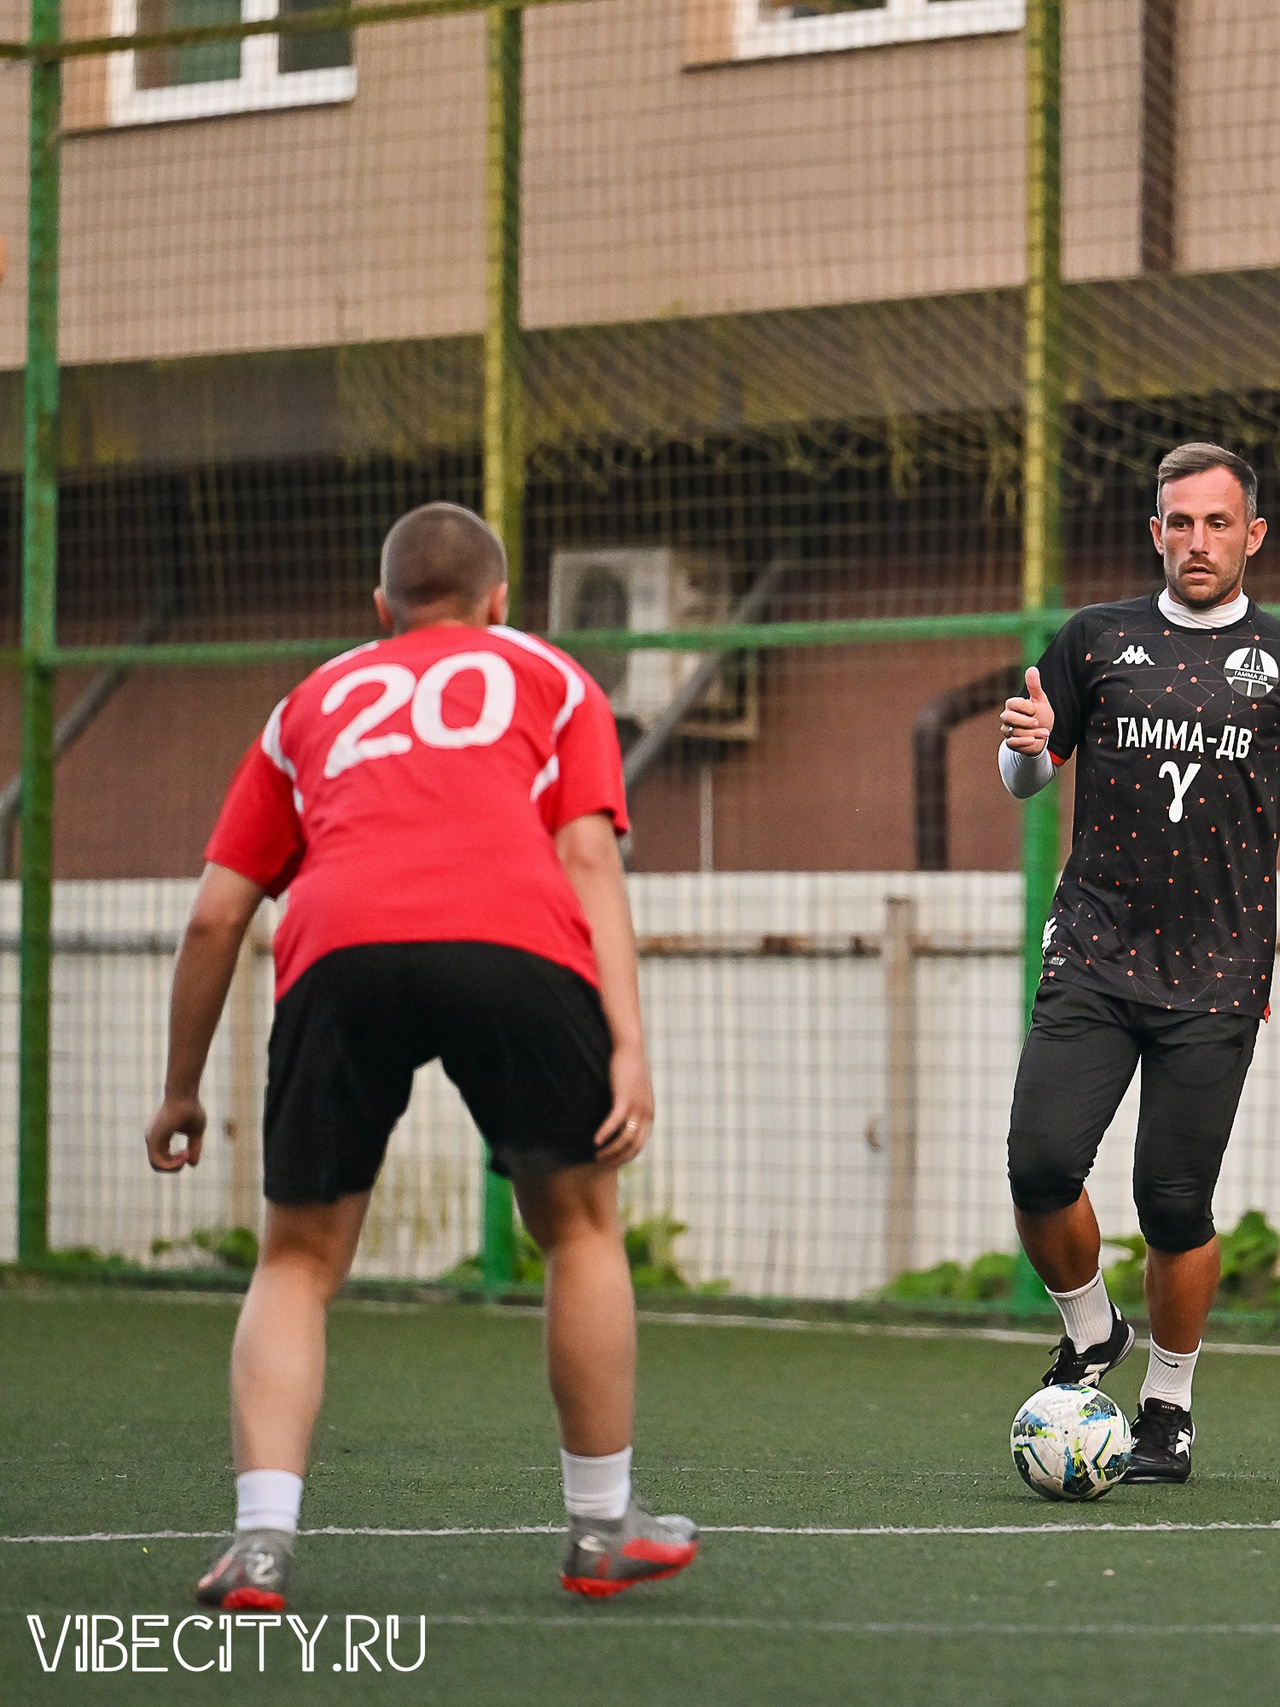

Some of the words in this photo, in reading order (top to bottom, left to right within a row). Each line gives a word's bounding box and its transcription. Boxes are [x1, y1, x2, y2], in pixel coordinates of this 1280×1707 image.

[1234, 670, 1258, 679] ГАММА
[321, 650, 517, 779] 20
[1117, 717, 1252, 761] ГАММА-ДВ
